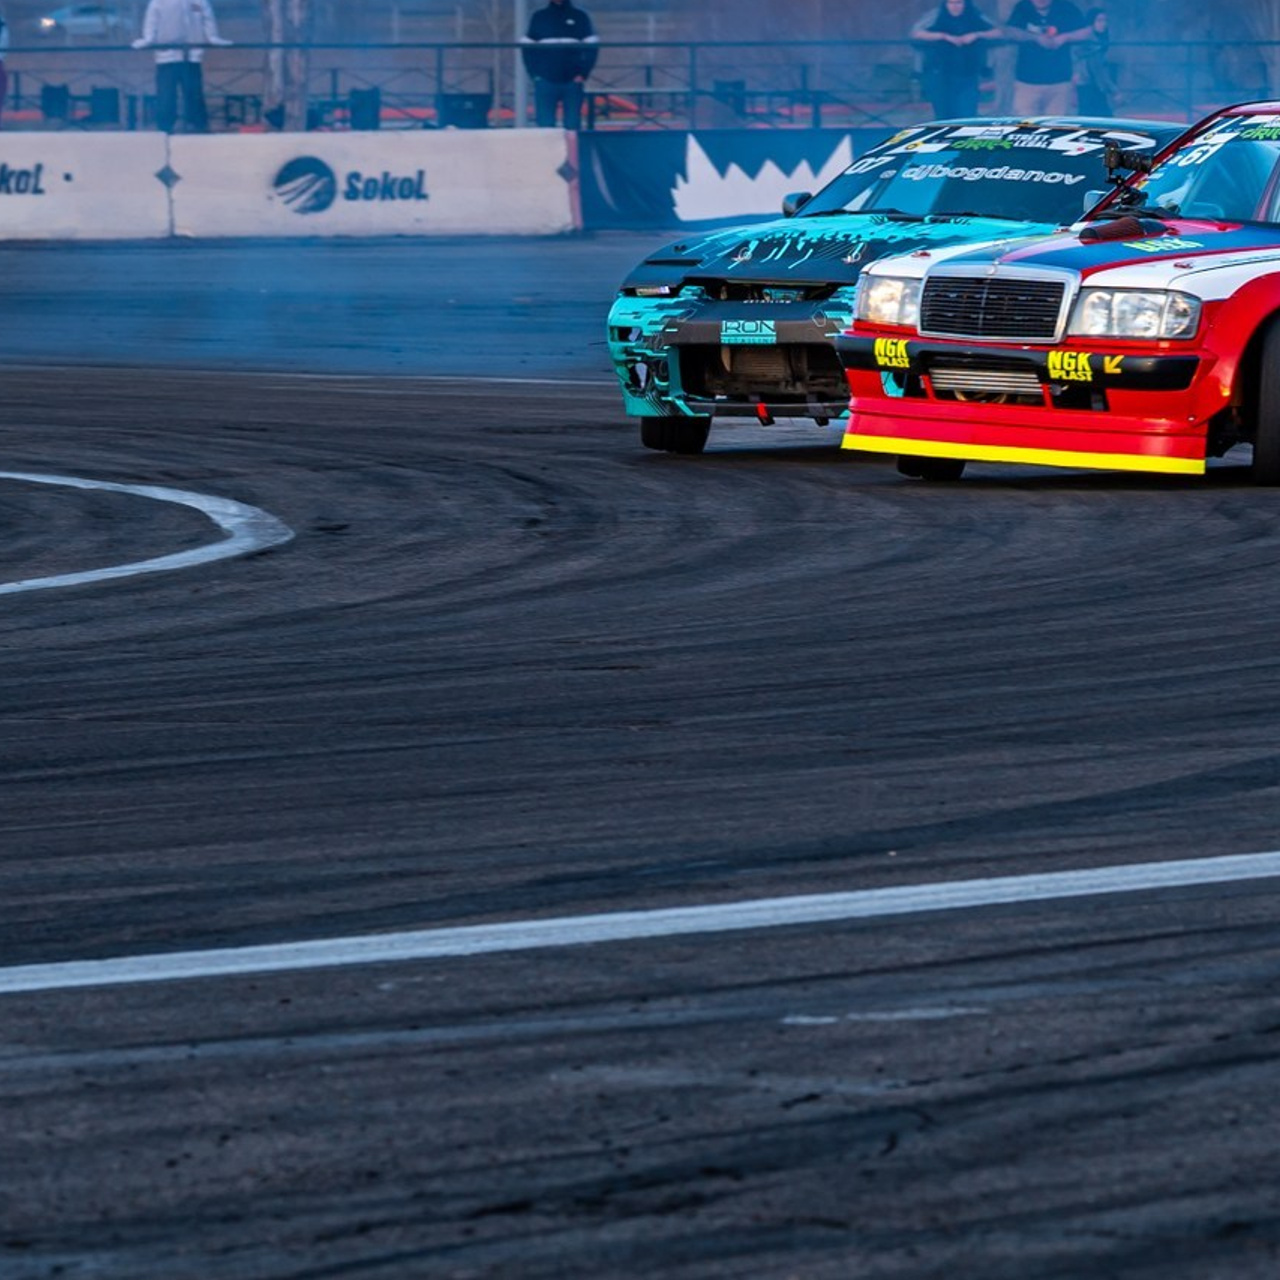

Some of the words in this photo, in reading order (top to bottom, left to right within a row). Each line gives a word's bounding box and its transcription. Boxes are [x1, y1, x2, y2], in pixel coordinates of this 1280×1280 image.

[846, 156, 896, 175] 07
[1178, 144, 1225, 167] 61
[902, 164, 1086, 185] djbogdanov
[874, 337, 909, 358] NGK
[1048, 350, 1092, 372] NGK
